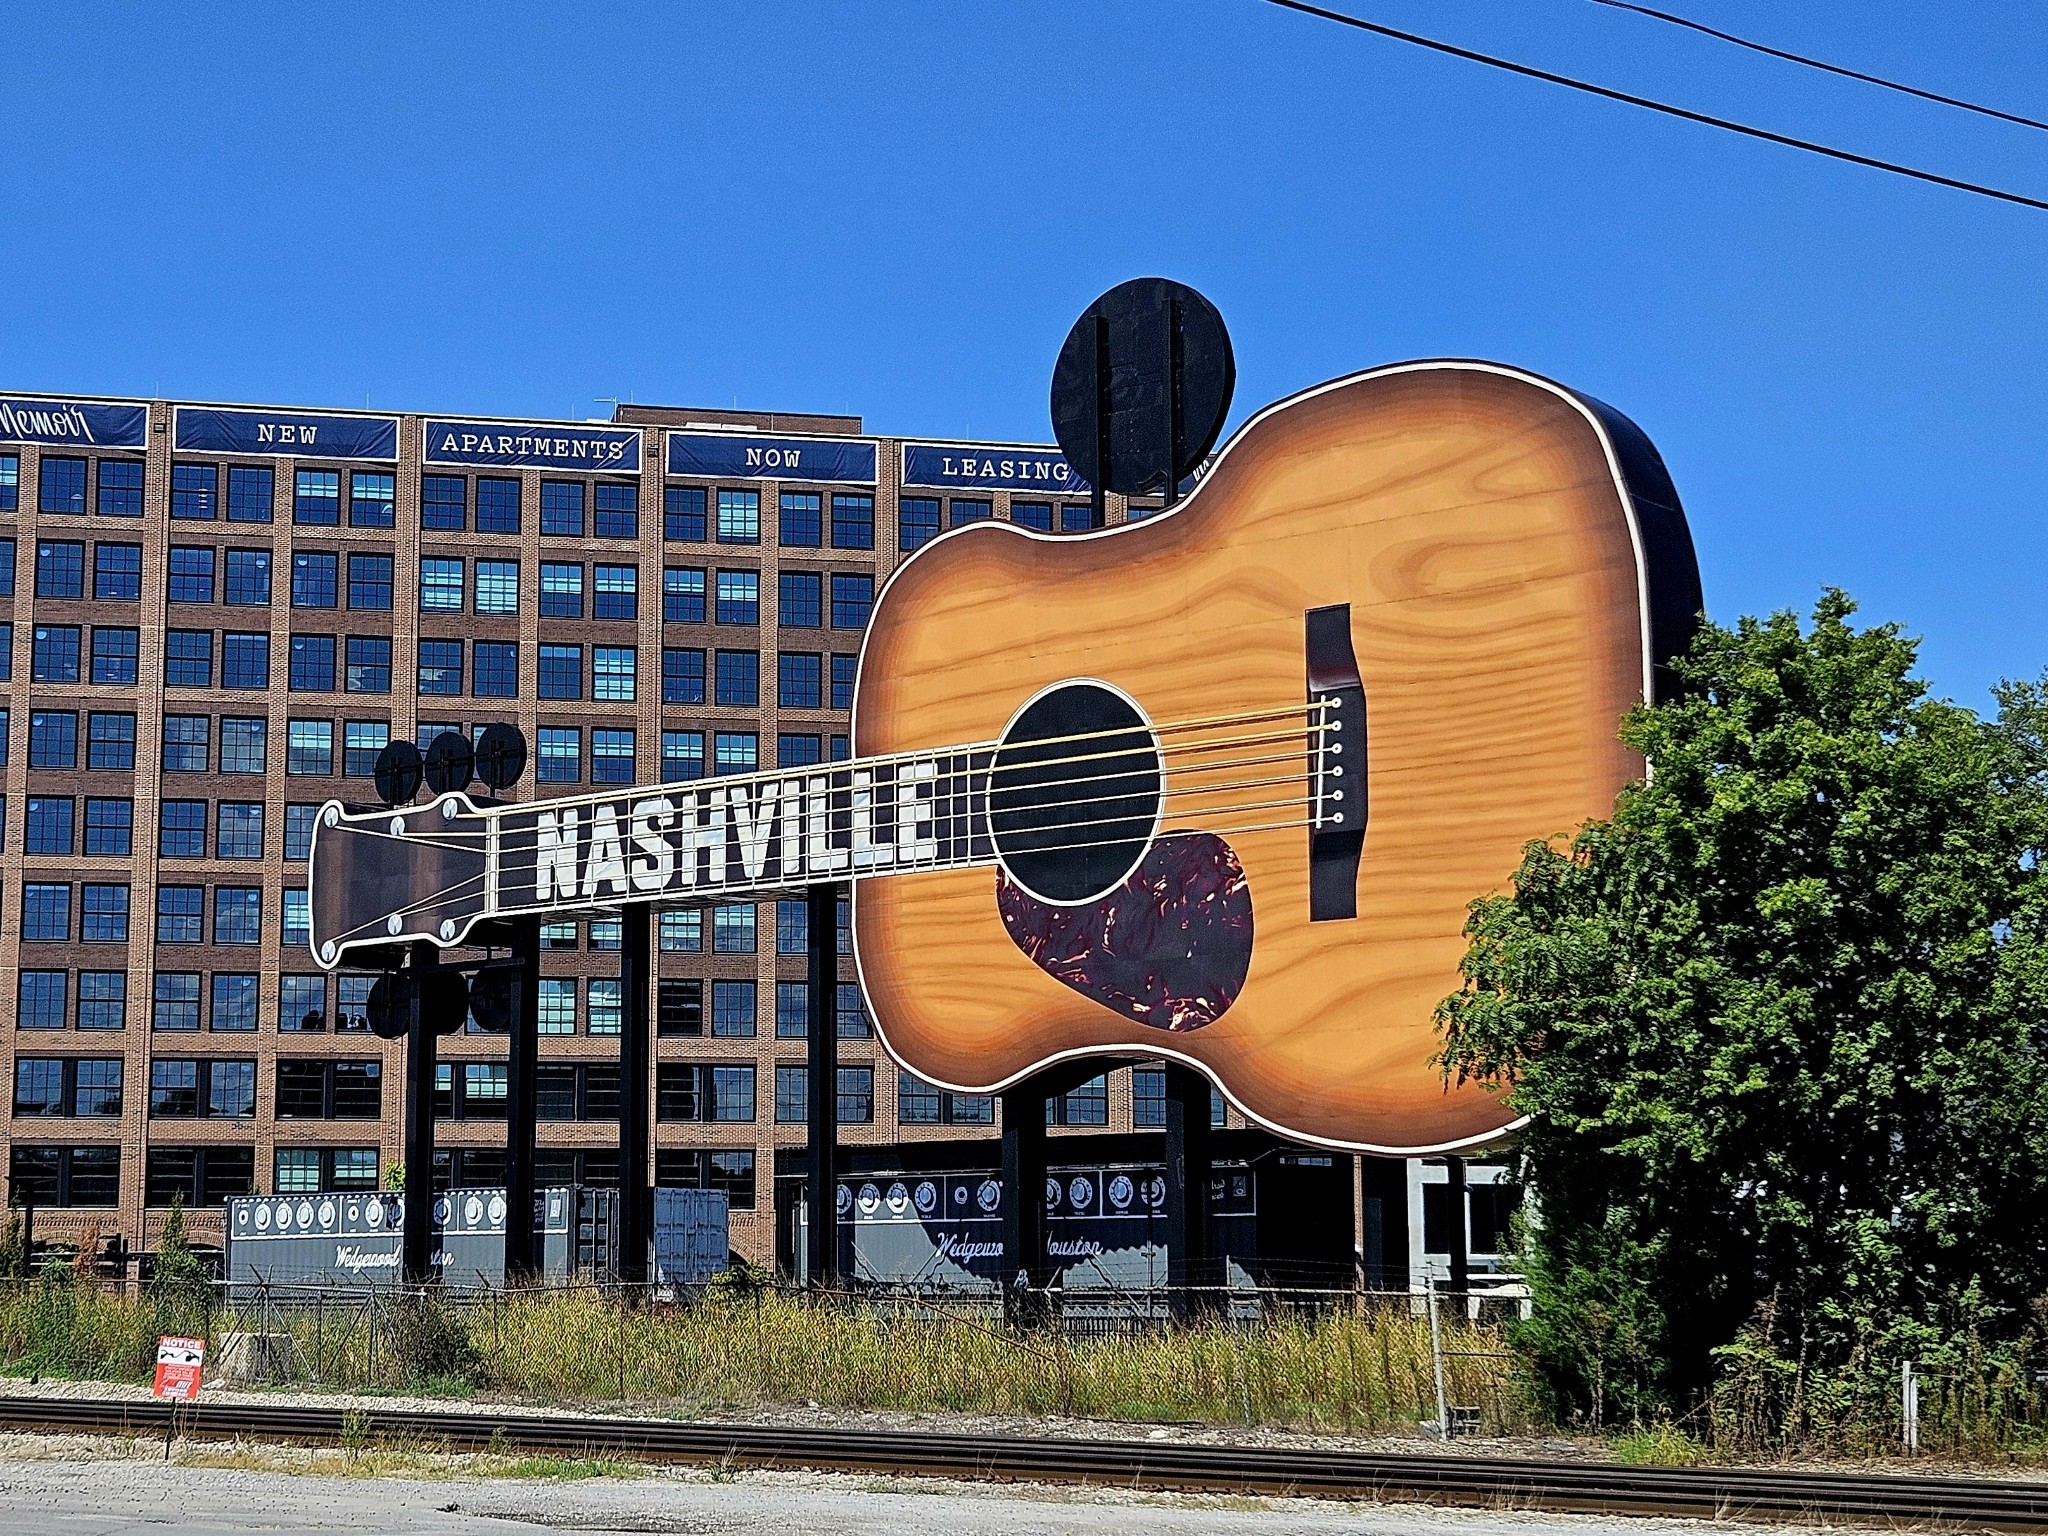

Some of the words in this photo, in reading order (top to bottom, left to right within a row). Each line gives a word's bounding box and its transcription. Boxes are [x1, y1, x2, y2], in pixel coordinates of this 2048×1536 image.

[257, 423, 318, 445] NEW
[441, 433, 624, 460] APARTMENTS
[745, 447, 801, 468] NOW
[942, 457, 1070, 481] LEASING
[535, 761, 939, 901] NASHVILLE
[334, 1243, 402, 1275] Wedgewood
[935, 1231, 1004, 1264] Wedgewo
[162, 1337, 202, 1350] NOTICE
